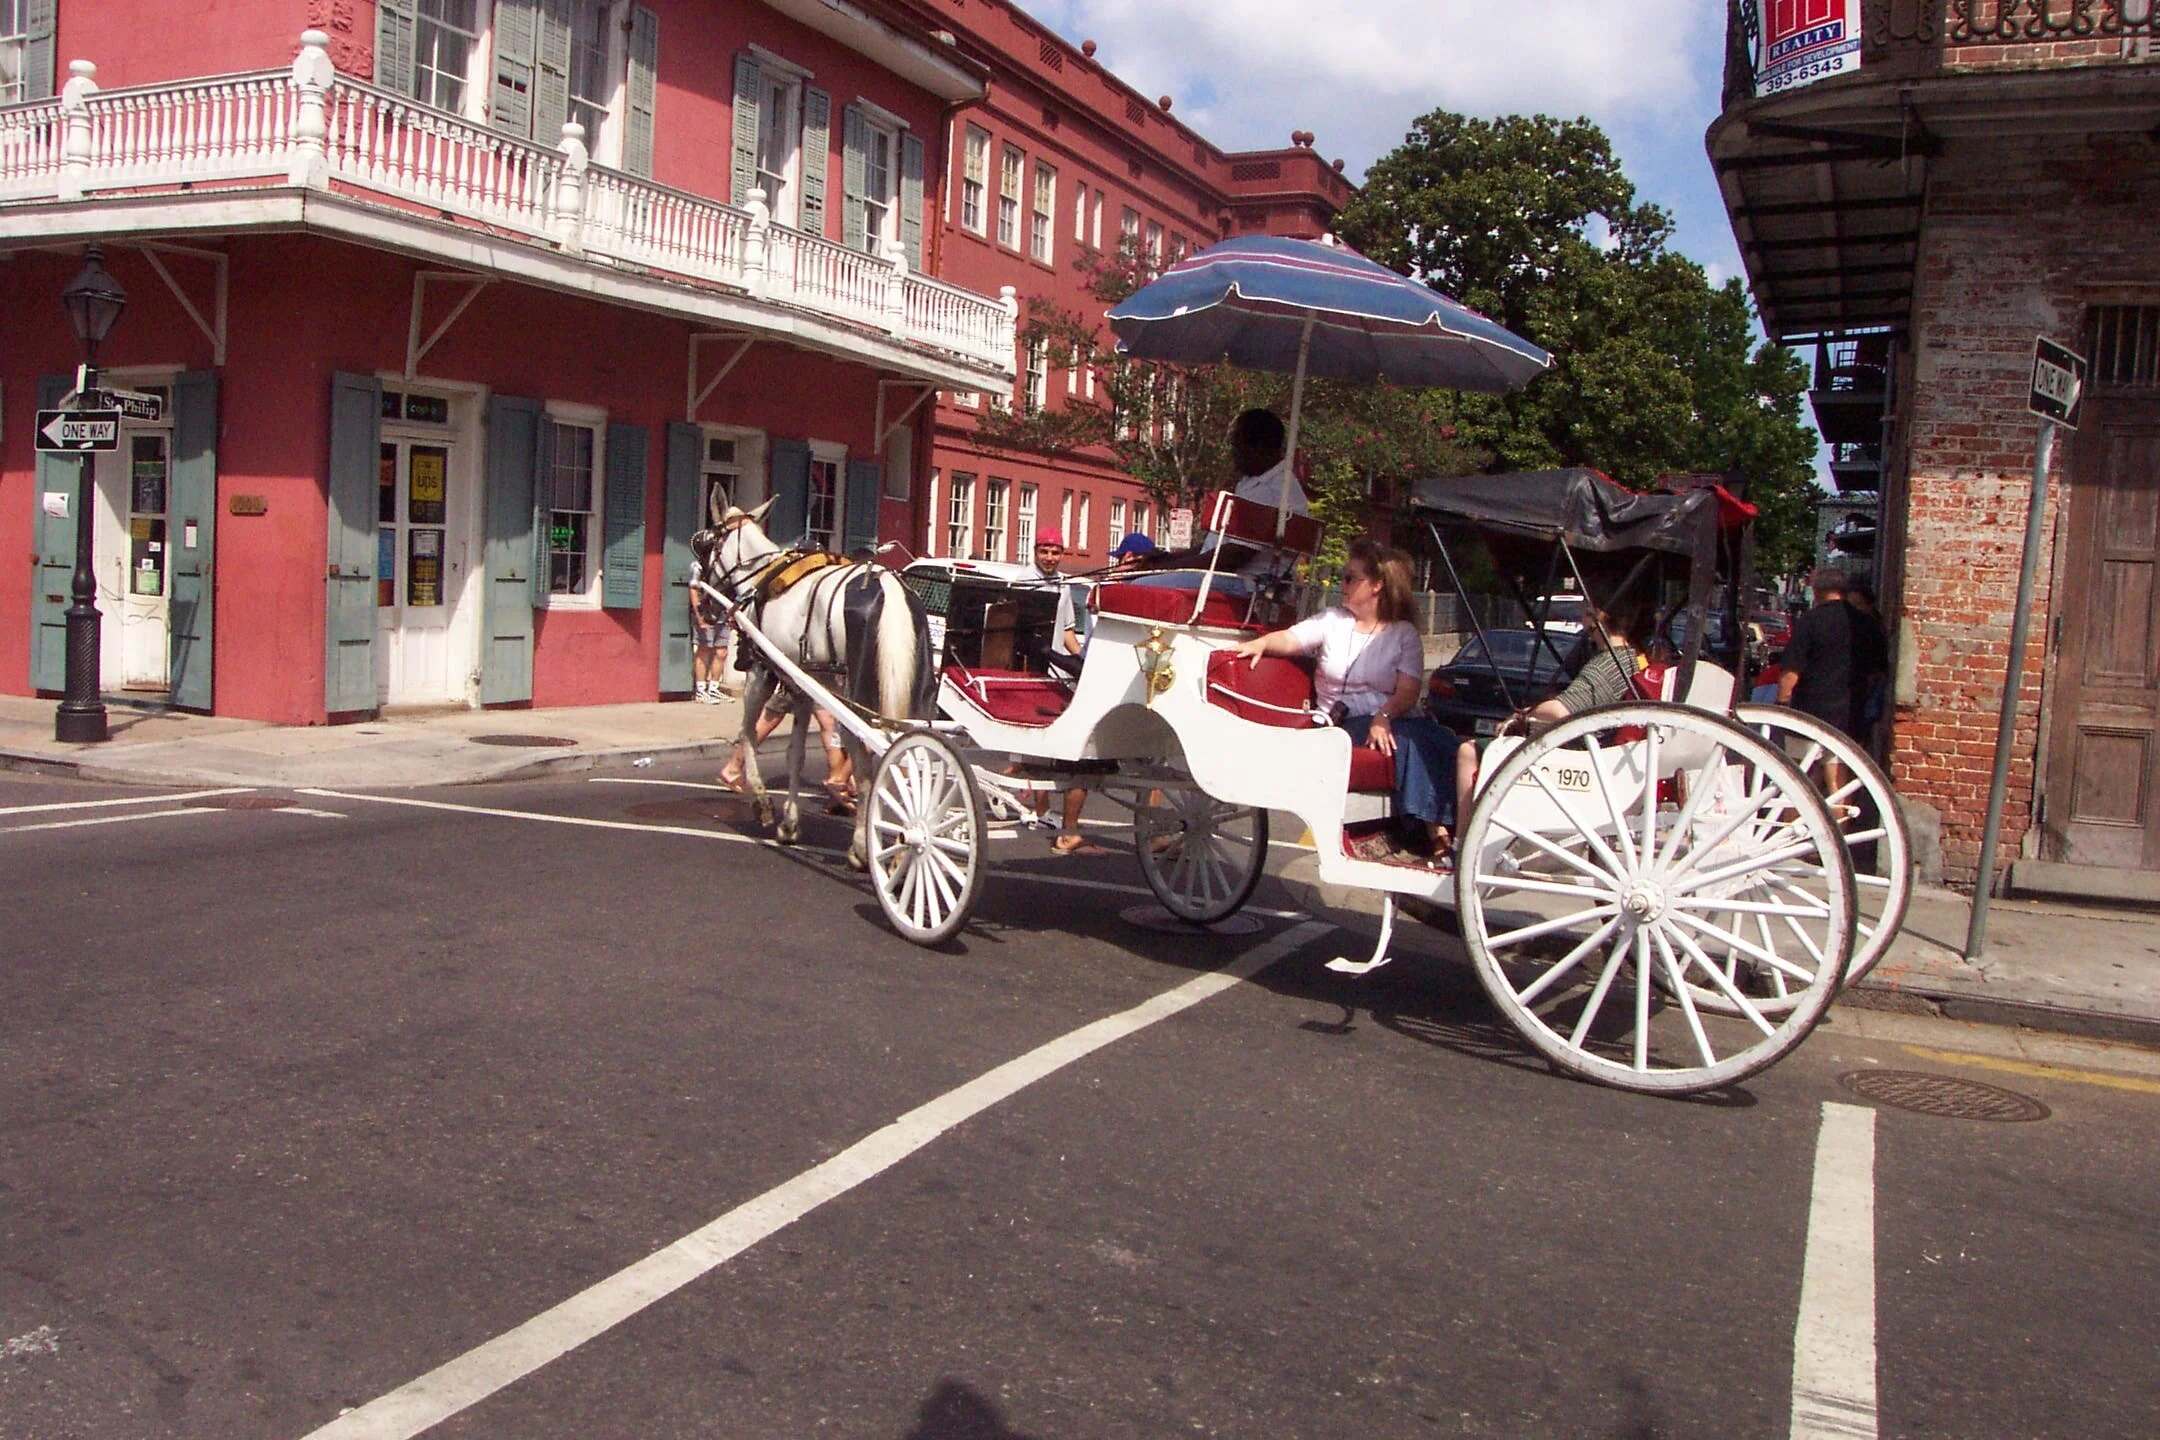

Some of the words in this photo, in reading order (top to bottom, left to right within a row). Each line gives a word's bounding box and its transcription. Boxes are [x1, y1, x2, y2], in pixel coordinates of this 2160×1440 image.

[1771, 25, 1837, 58] REALTY
[1766, 57, 1843, 93] 393-6343
[124, 399, 157, 420] Philip
[62, 423, 87, 438] ONE
[89, 423, 111, 438] WAY
[417, 475, 439, 493] ups
[1557, 768, 1590, 788] 1970
